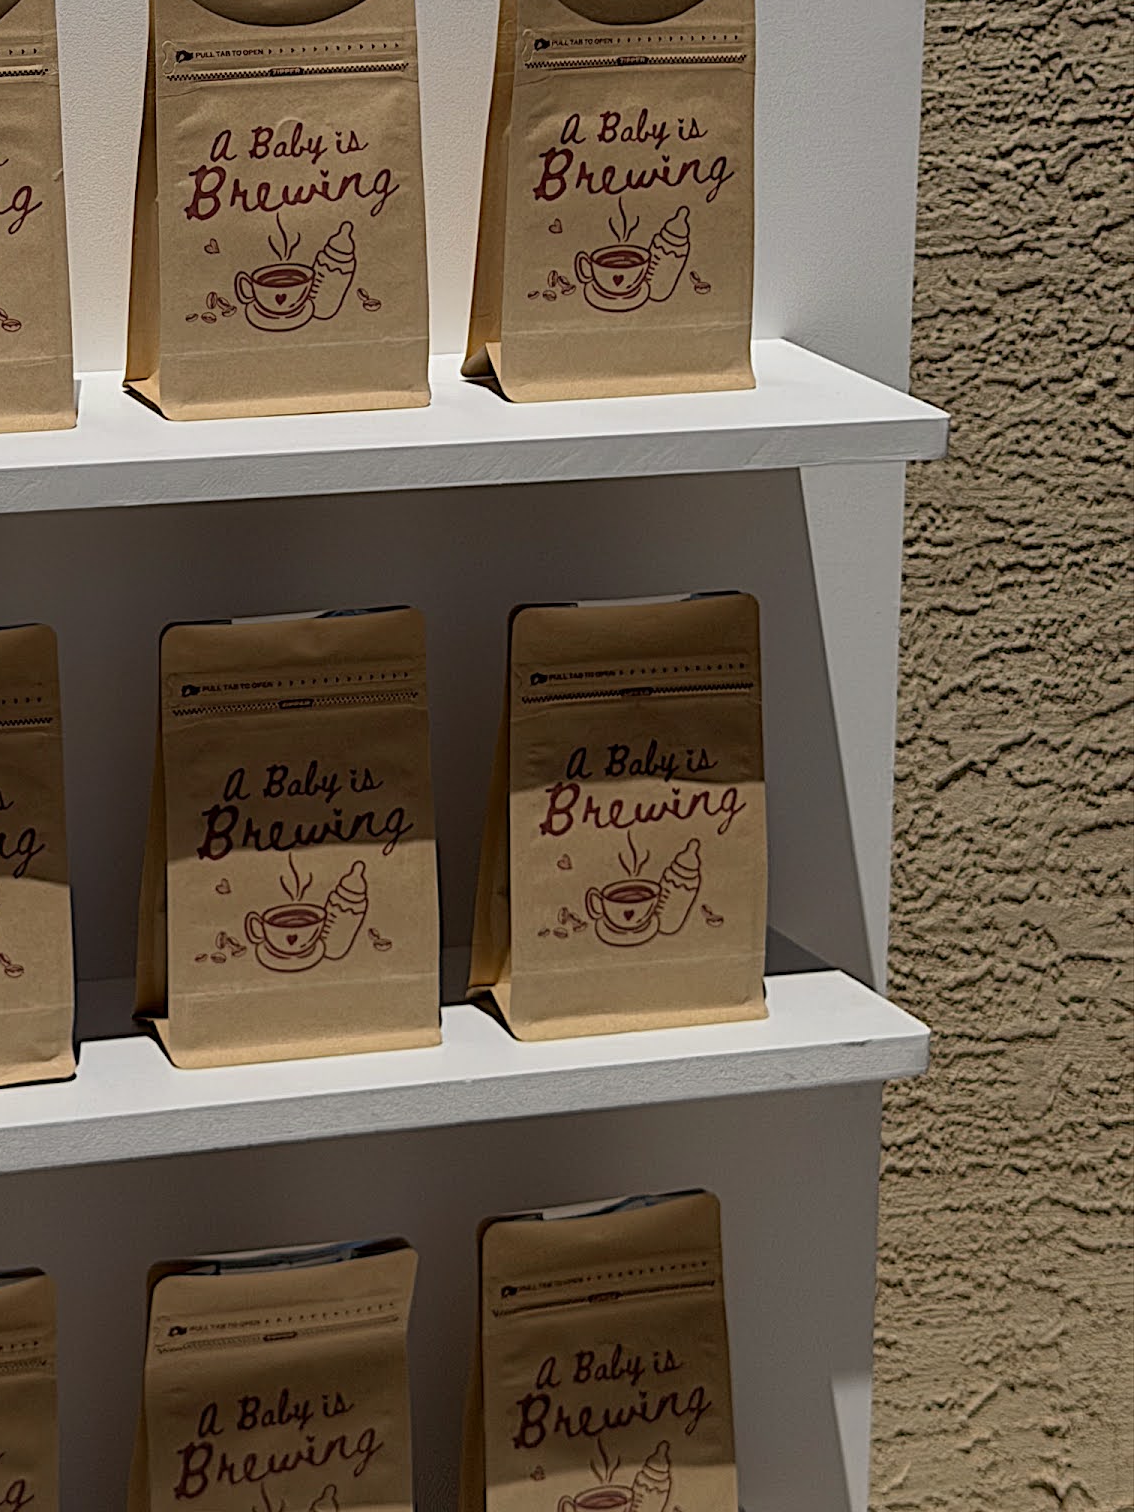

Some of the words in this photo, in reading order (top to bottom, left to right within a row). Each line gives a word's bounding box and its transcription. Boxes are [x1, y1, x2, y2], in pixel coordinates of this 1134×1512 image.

[196, 51, 213, 59] PULL
[210, 129, 235, 162] A
[248, 122, 327, 166] Baby
[336, 130, 370, 154] is
[561, 112, 583, 145] A
[597, 108, 672, 150] Baby
[678, 116, 708, 139] is
[184, 166, 400, 222] Brewing
[533, 145, 734, 203] Brewing
[223, 767, 249, 802] A
[264, 760, 340, 802] Baby
[348, 767, 384, 793] is
[566, 746, 591, 781] A
[605, 738, 679, 781] Baby
[686, 746, 718, 772] is
[197, 803, 414, 861] Brewing
[540, 781, 747, 836] Brewing
[536, 1355, 562, 1390] A
[572, 1344, 645, 1385] Baby
[652, 1351, 683, 1374] is
[197, 1402, 225, 1439] A
[236, 1388, 315, 1433] Baby
[322, 1392, 355, 1418] is
[512, 1386, 712, 1452] Brewing
[173, 1425, 384, 1501] Brewing
